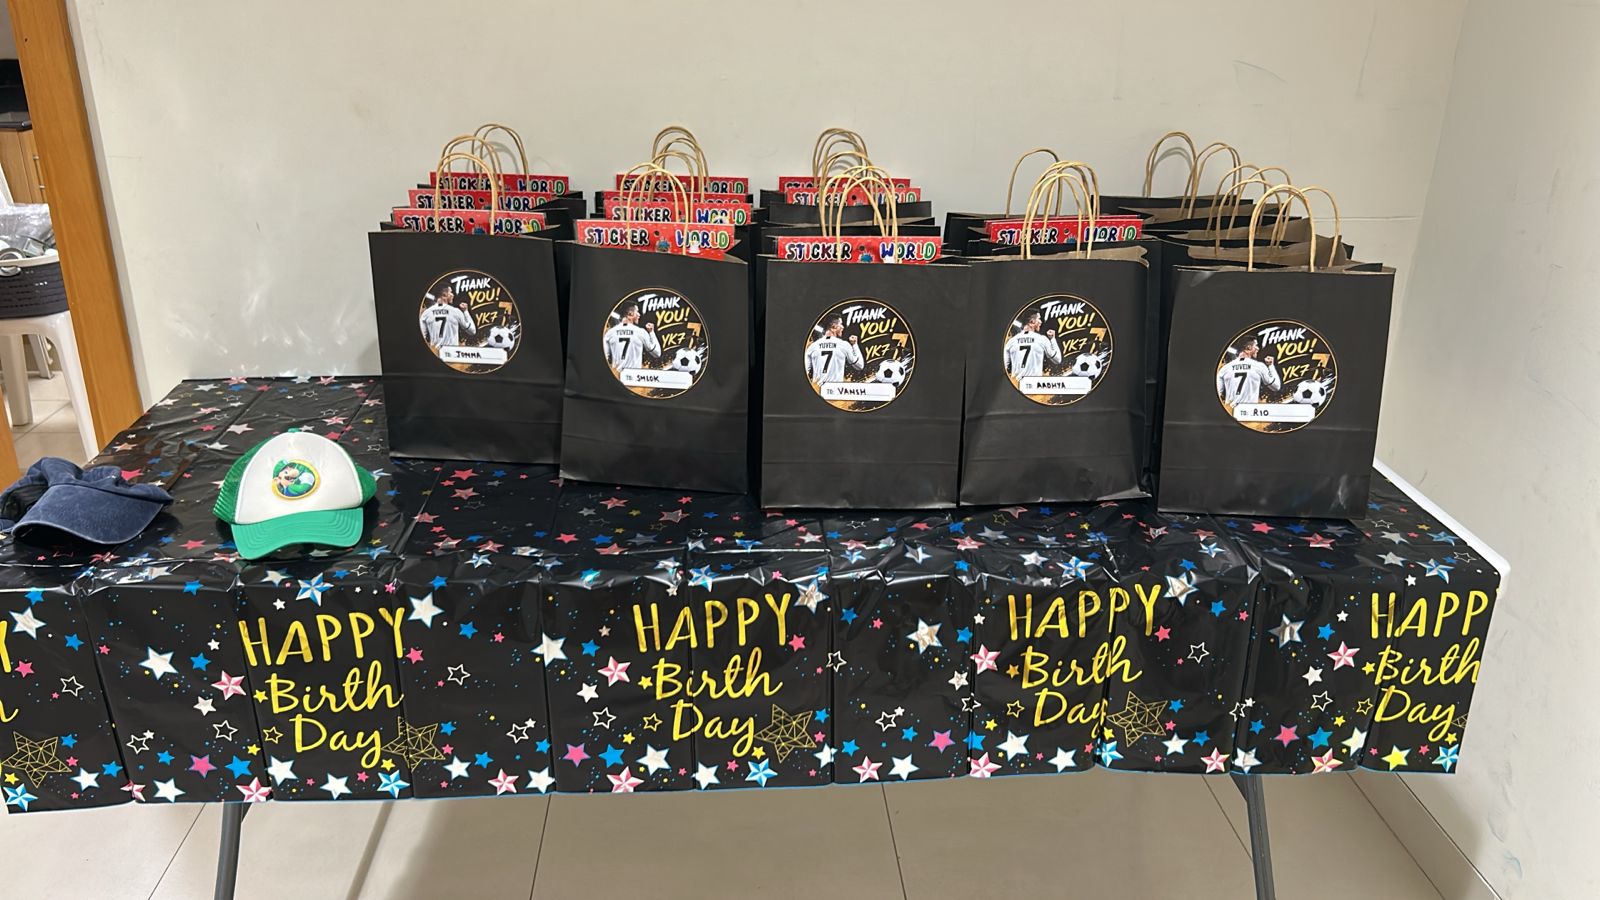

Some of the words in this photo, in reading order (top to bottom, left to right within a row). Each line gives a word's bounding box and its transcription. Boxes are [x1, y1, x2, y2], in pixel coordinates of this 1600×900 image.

[403, 215, 465, 233] STICKER
[584, 227, 650, 246] STICKER
[675, 229, 730, 249] WORLD
[997, 227, 1058, 245] STIKER
[785, 242, 852, 260] STICKER
[879, 241, 936, 260] WORLD
[451, 275, 491, 294] THANK
[468, 287, 500, 306] YOU!
[638, 293, 681, 314] THANK
[475, 311, 498, 327] YK7
[655, 307, 690, 327] YOU!
[842, 305, 887, 327] THANK
[1040, 300, 1086, 322] THANK
[434, 316, 447, 338] 7
[859, 317, 897, 340] YOU!
[1057, 312, 1096, 334] YOU!
[661, 332, 686, 349] YK7
[1062, 338, 1088, 354] YK7
[1258, 326, 1307, 348] THANK
[618, 337, 631, 360] 7
[865, 343, 890, 361] YK7
[1019, 345, 1032, 369] 7
[1276, 338, 1318, 361] YOU!
[821, 350, 833, 374] 7
[1234, 372, 1248, 396] 7
[1282, 364, 1310, 383] YK7
[1253, 408, 1269, 417] RIO
[632, 593, 791, 652] HAPPY
[1007, 583, 1161, 641] HAPPY
[238, 607, 405, 666] HAPPY
[1020, 635, 1143, 689] Birth
[1374, 637, 1481, 685] Birth
[652, 646, 783, 700] Birth
[264, 660, 405, 714] Birth
[1034, 688, 1108, 739] Day
[1374, 685, 1456, 742] Day
[670, 699, 755, 757] Day
[288, 713, 381, 769] Day
